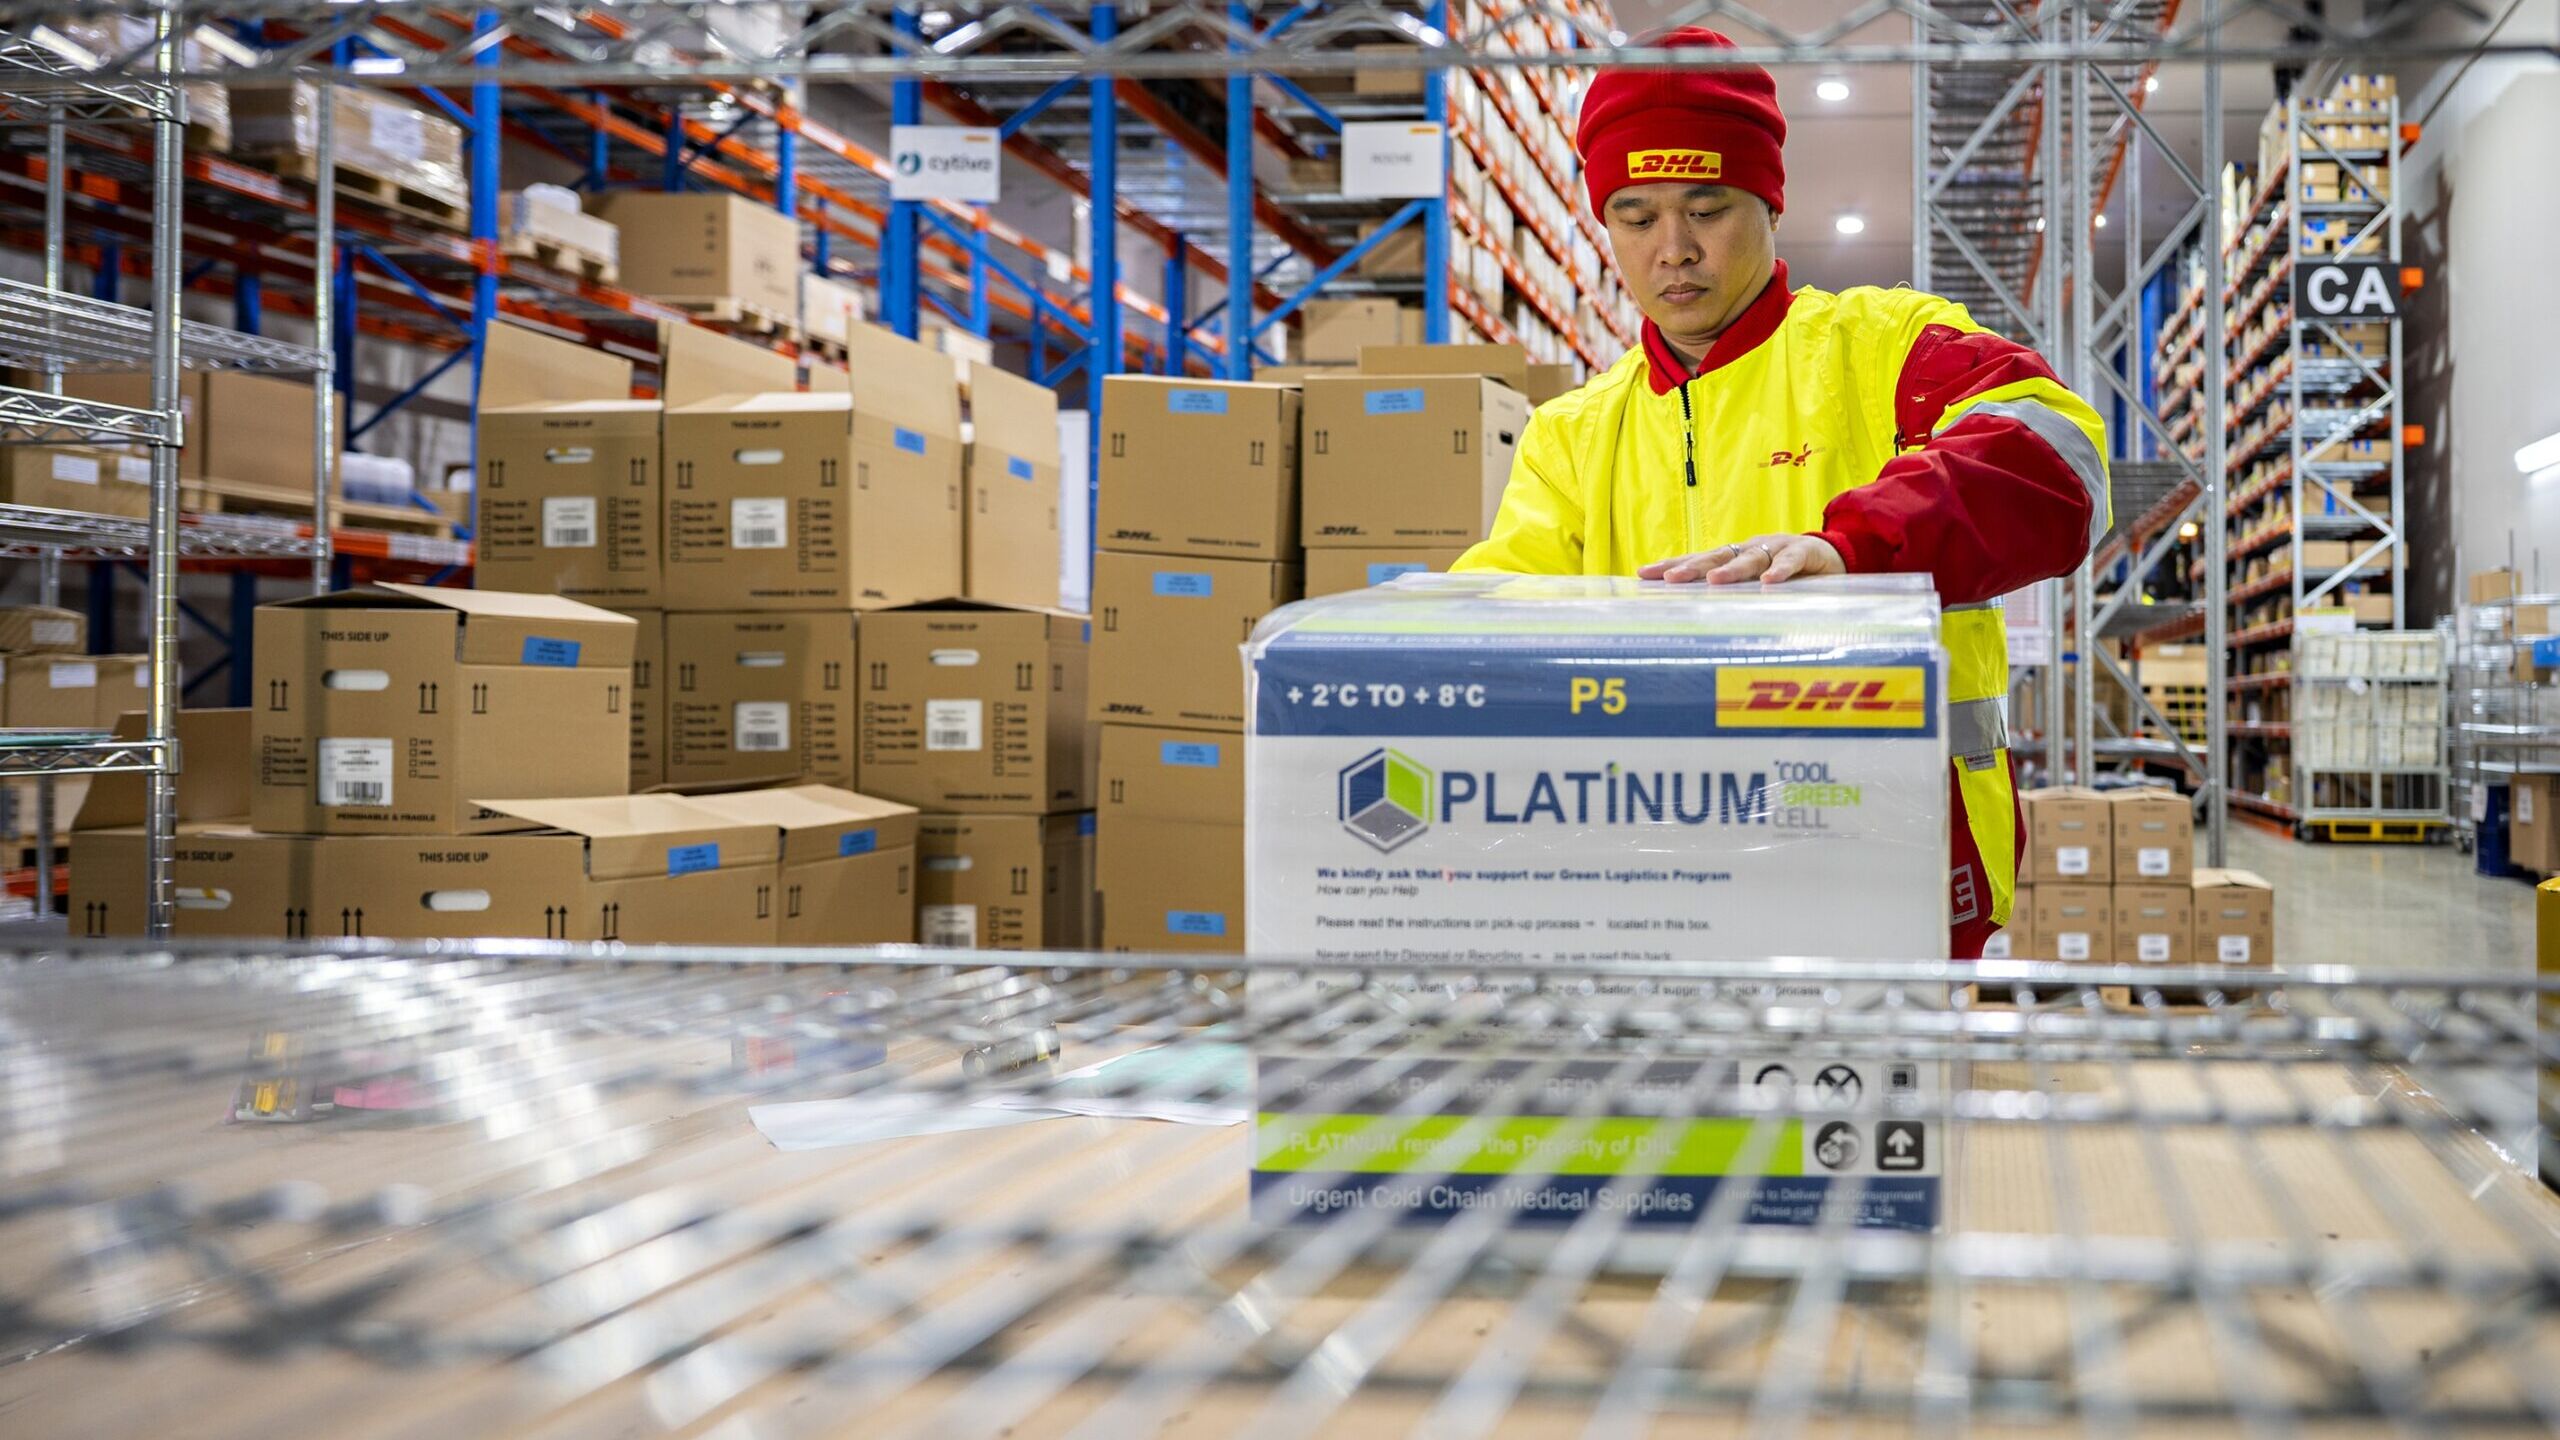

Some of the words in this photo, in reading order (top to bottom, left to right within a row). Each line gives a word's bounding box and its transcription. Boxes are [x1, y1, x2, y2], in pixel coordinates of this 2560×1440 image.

[1641, 154, 1708, 173] DHL
[2307, 266, 2395, 314] CA
[320, 631, 344, 641] THIS
[347, 631, 371, 641] SIDE
[374, 632, 389, 642] UP
[1312, 684, 1358, 706] 2°C
[1366, 684, 1405, 706] TO
[1438, 684, 1486, 707] 8°C
[1571, 677, 1627, 715] P5
[1746, 681, 1894, 711] DHL
[1783, 784, 1861, 806] GREEN
[1773, 808, 1829, 829] CELL
[191, 851, 216, 861] SIDE
[218, 851, 234, 862] UP
[418, 852, 443, 862] THIS
[446, 852, 471, 862] SIDE
[473, 852, 488, 862] UP
[1317, 868, 1338, 879] We
[1342, 868, 1382, 881] kindly
[1387, 868, 1409, 879] ask
[1415, 868, 1443, 879] that
[1447, 871, 1471, 882] you
[1476, 870, 1529, 881] support
[1533, 871, 1555, 880] our
[1560, 869, 1600, 880] Green
[1605, 869, 1668, 882] Logistics
[1673, 869, 1731, 882] Program
[1317, 885, 1341, 895] How
[1345, 887, 1366, 896] can
[1369, 887, 1389, 898] you
[1393, 885, 1420, 898] Help
[1316, 916, 1354, 928] Please
[1358, 916, 1384, 928] read
[1387, 916, 1403, 928] the
[1408, 916, 1470, 928] instructions
[1474, 918, 1488, 928] on
[1491, 917, 1533, 930] pick-up
[1536, 919, 1581, 931] process
[1607, 918, 1648, 929] located
[1652, 919, 1661, 929] in
[1664, 919, 1684, 930] this
[1487, 1134, 1518, 1155] the
[1609, 1134, 1631, 1156] of
[1290, 1185, 1363, 1212] Urgent
[1371, 1185, 1422, 1207] Cold
[1428, 1185, 1496, 1209] Chain
[1503, 1186, 1590, 1211] Medical
[1595, 1188, 1695, 1213] Supplies
